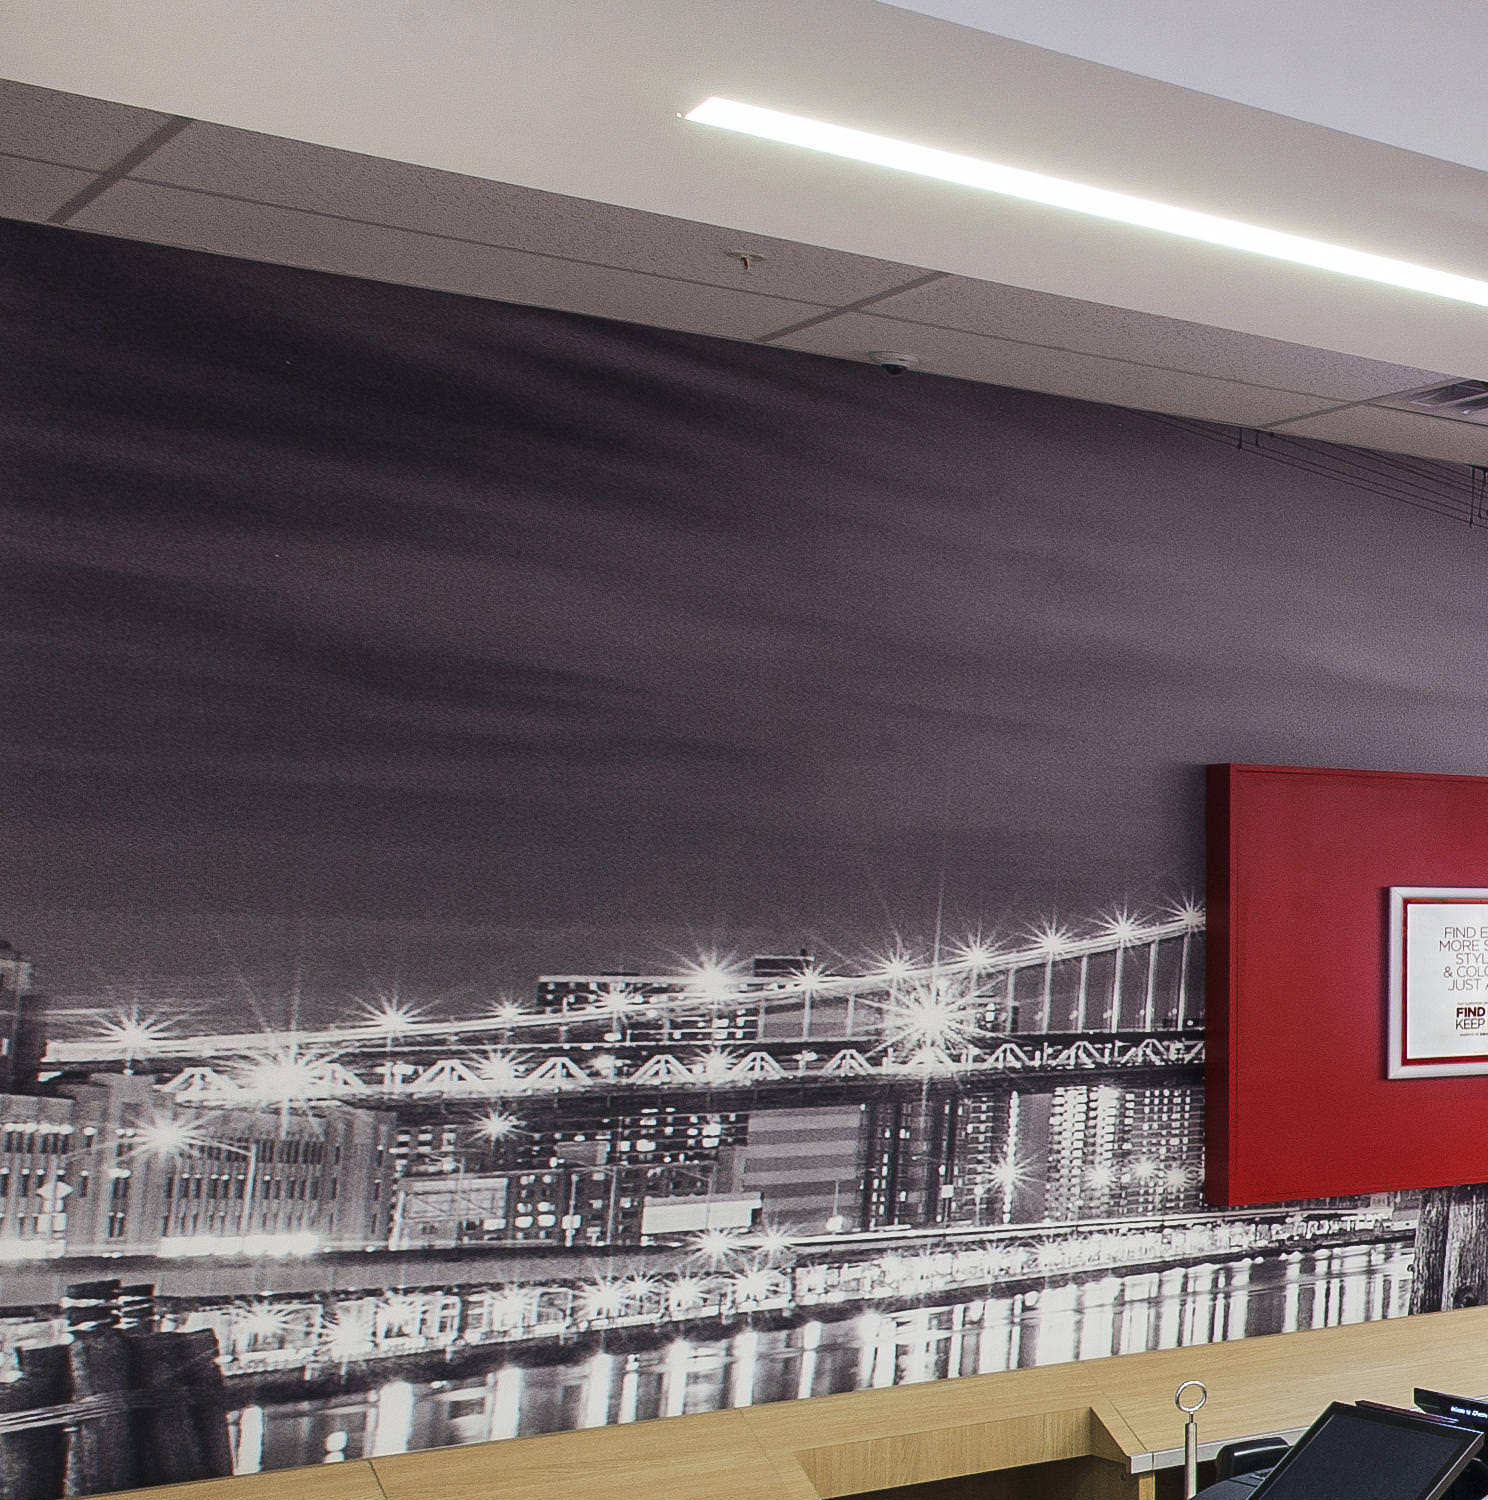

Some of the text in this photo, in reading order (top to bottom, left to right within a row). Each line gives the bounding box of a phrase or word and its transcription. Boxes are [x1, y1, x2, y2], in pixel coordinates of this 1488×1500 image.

[1444, 927, 1476, 939] FIND
[1439, 940, 1480, 952] MORE
[1443, 966, 1452, 977] &
[1448, 979, 1479, 991] JUST
[1456, 1007, 1485, 1018] FIND
[1456, 1019, 1485, 1030] KEEP
